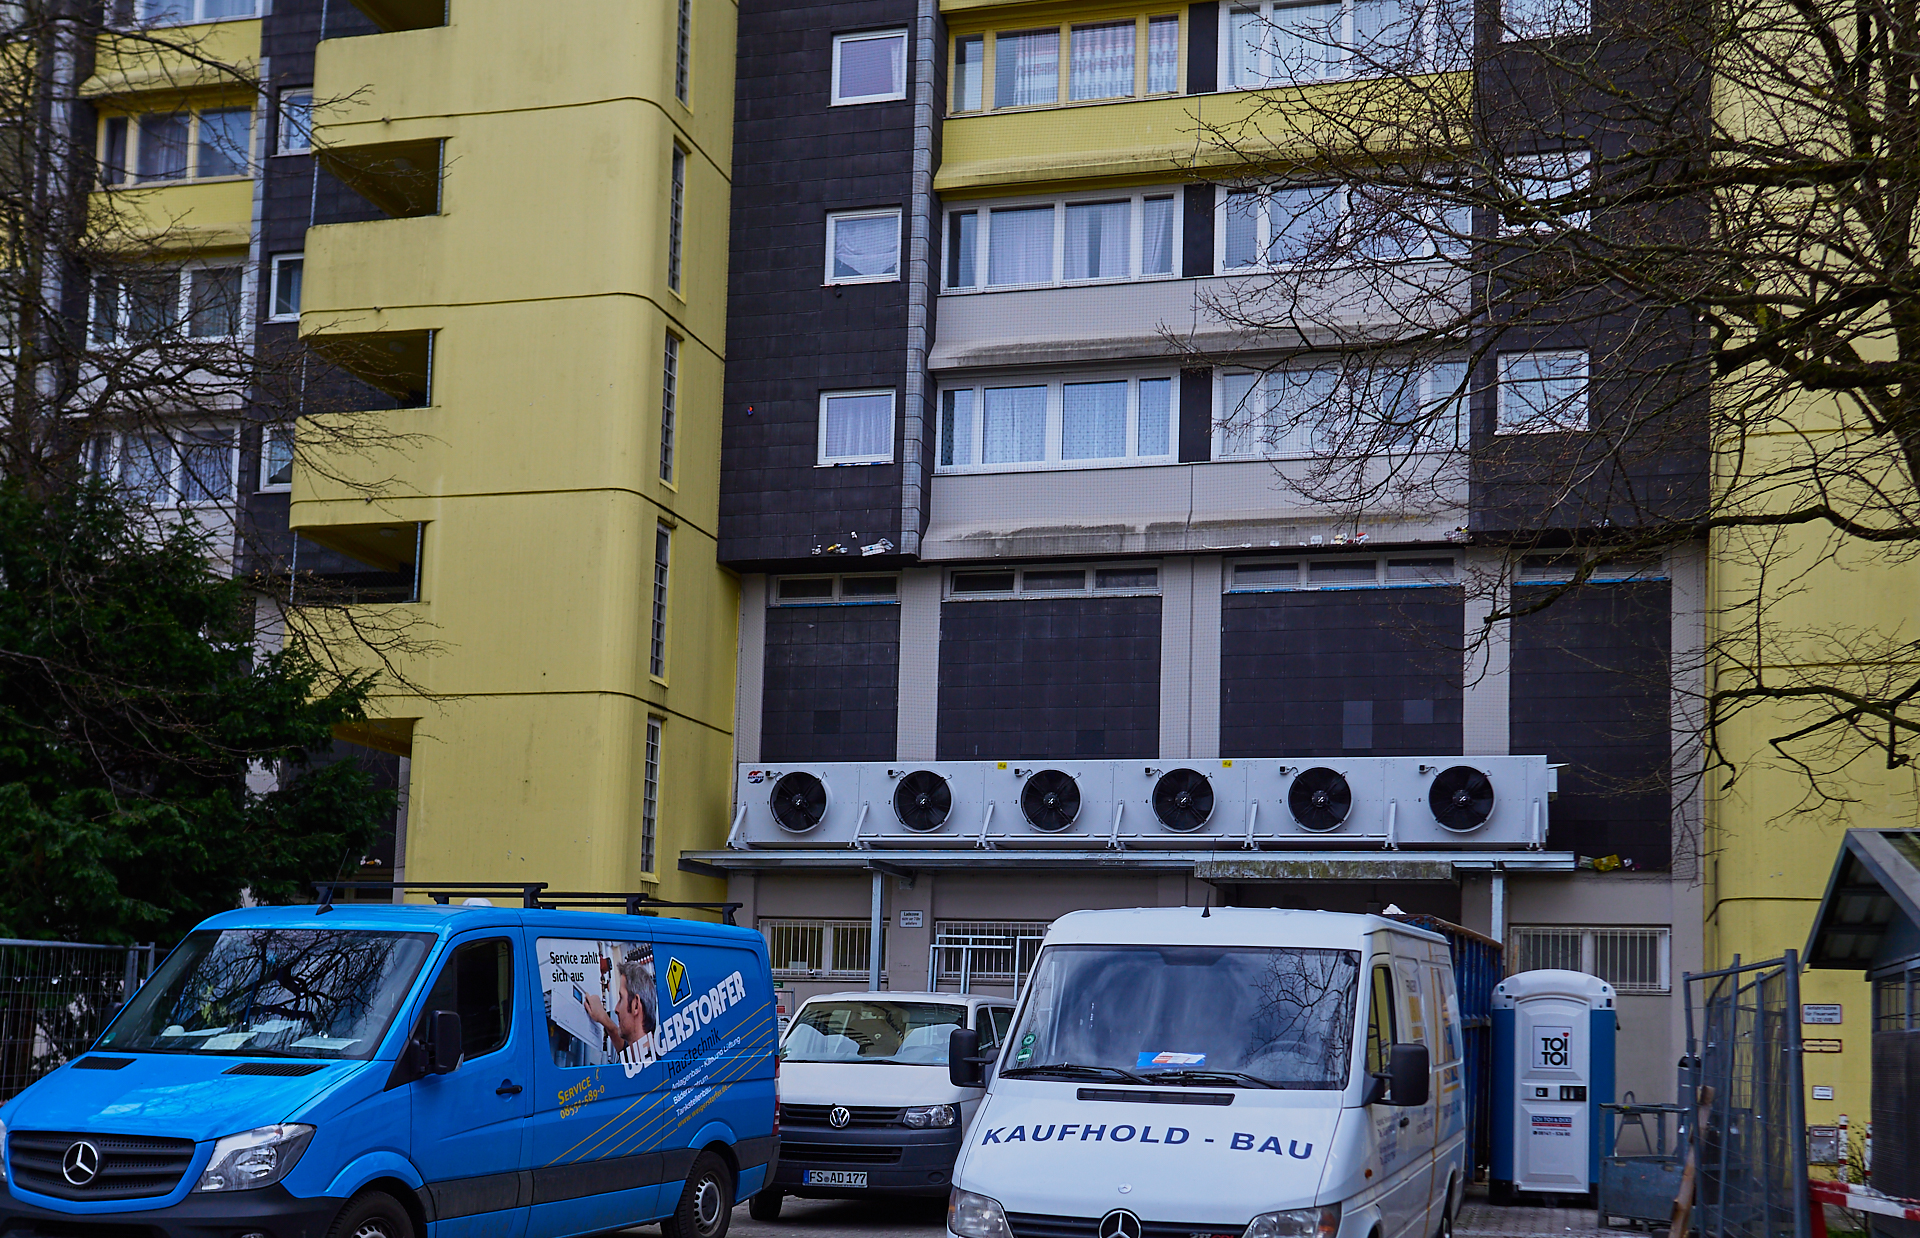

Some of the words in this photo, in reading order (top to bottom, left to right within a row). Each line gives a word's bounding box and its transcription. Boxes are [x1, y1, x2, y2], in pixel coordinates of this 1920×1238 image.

[550, 951, 578, 964] Service
[580, 951, 599, 964] zahlt
[552, 969, 568, 982] sich
[570, 972, 584, 982] aus
[620, 970, 746, 1078] WEIGERSTORFER
[668, 1027, 721, 1078] Haustechnik
[1541, 1036, 1568, 1051] TOI
[671, 1065, 702, 1091] Anlagenbau
[724, 1036, 741, 1052] Lüftung
[1541, 1051, 1568, 1066] TOI
[558, 1076, 592, 1105] SERVICE
[981, 1124, 1190, 1146] KAUFHOLD
[1229, 1132, 1314, 1160] BAU
[810, 1171, 824, 1183] FS
[830, 1172, 844, 1183] AD
[846, 1172, 866, 1184] 177
